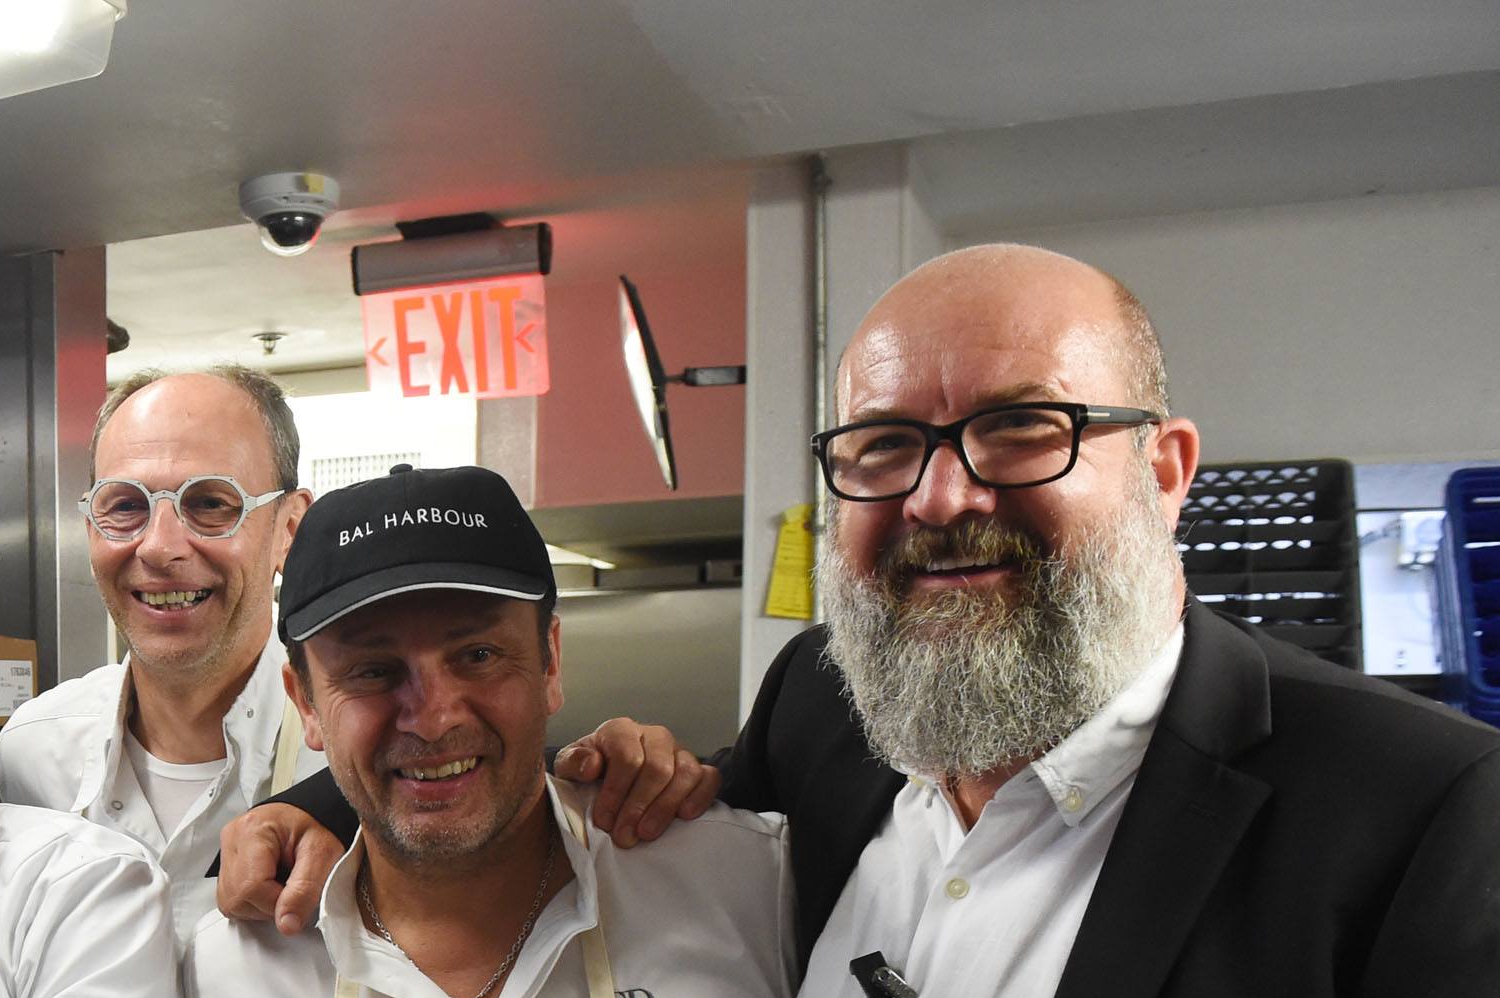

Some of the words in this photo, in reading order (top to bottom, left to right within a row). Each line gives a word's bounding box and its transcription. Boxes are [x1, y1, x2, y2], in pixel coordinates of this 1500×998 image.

[393, 286, 522, 397] EXIT
[339, 522, 374, 546] BAL
[384, 507, 488, 528] HARBOUR
